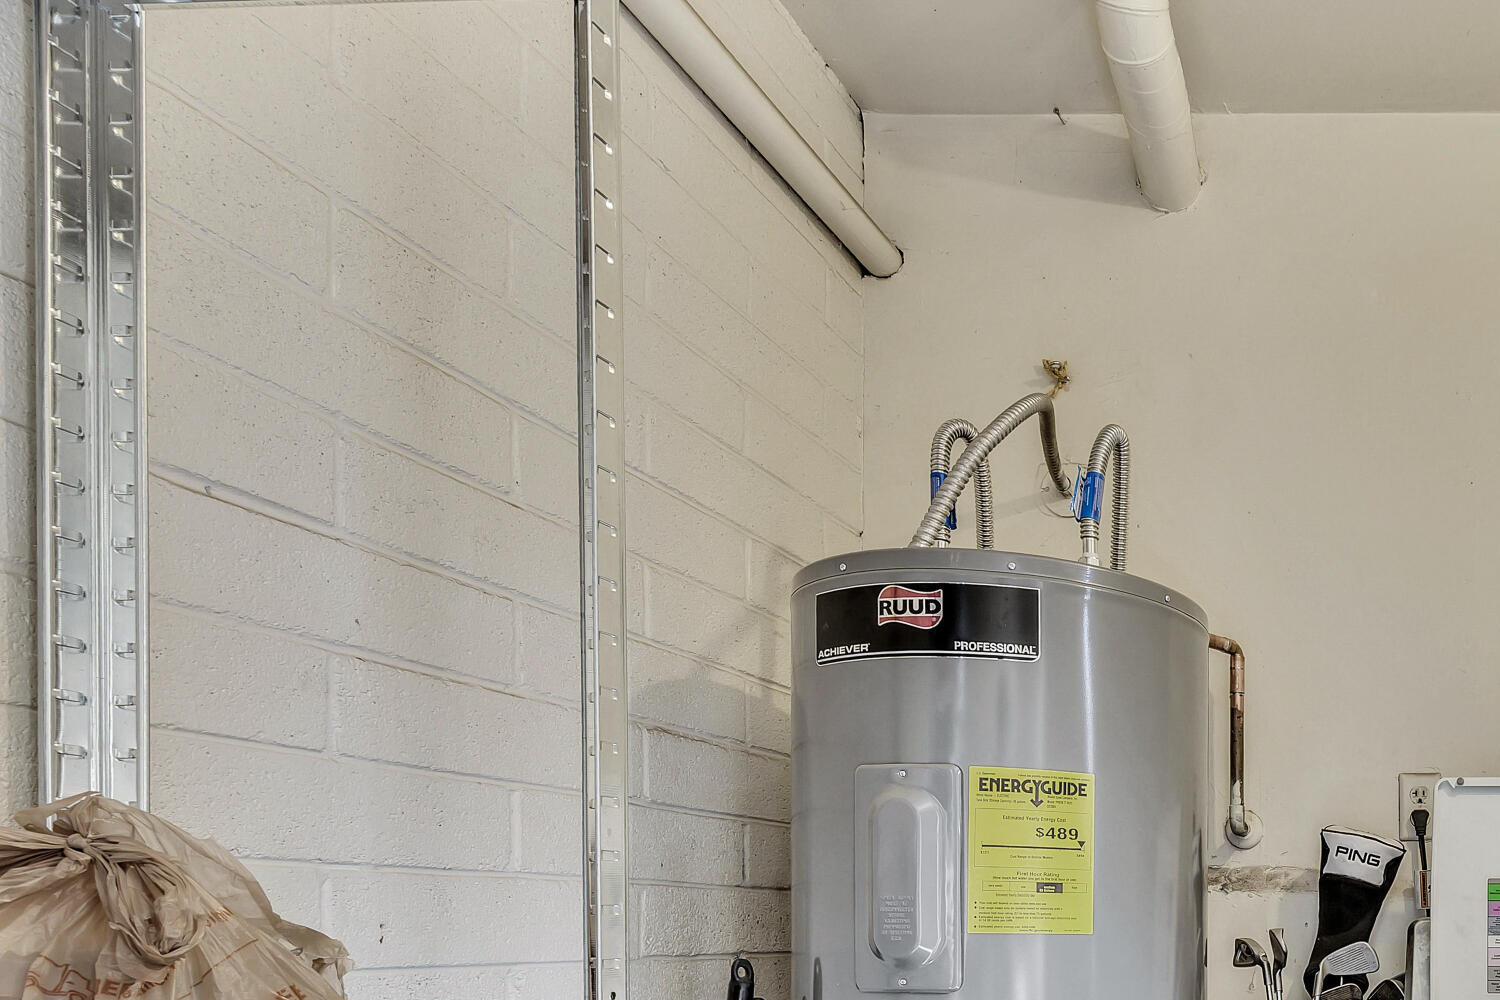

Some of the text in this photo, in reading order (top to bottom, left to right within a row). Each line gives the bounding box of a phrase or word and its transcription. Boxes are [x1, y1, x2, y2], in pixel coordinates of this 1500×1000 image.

[879, 599, 941, 616] RUUD
[818, 643, 870, 658] ACHIEVER
[954, 640, 1036, 655] PROFESSIONAL
[979, 777, 1087, 797] ENERGYGUIDE
[1035, 827, 1079, 841] $489
[1335, 845, 1381, 867] PING
